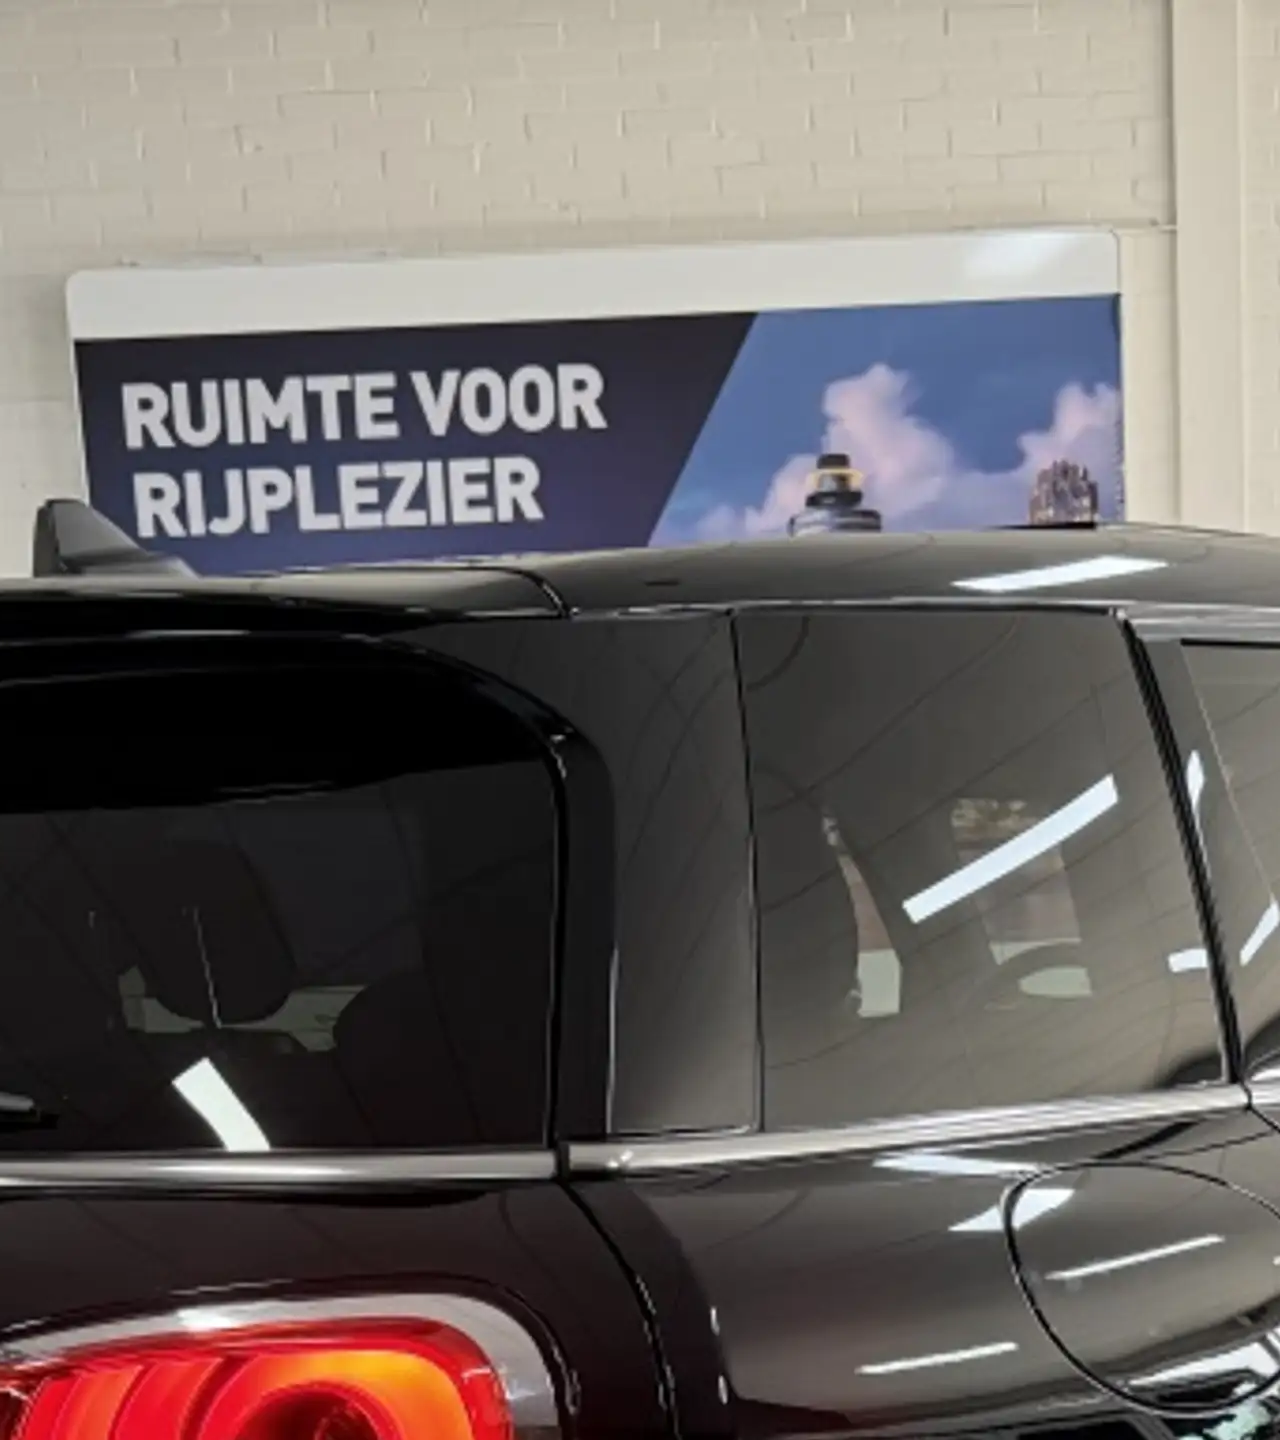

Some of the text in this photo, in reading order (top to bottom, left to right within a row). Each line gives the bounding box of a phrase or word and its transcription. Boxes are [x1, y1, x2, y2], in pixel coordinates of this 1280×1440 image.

[122, 363, 608, 449] RUIMTE VOOR
[133, 456, 545, 538] RIJPLEZIER
